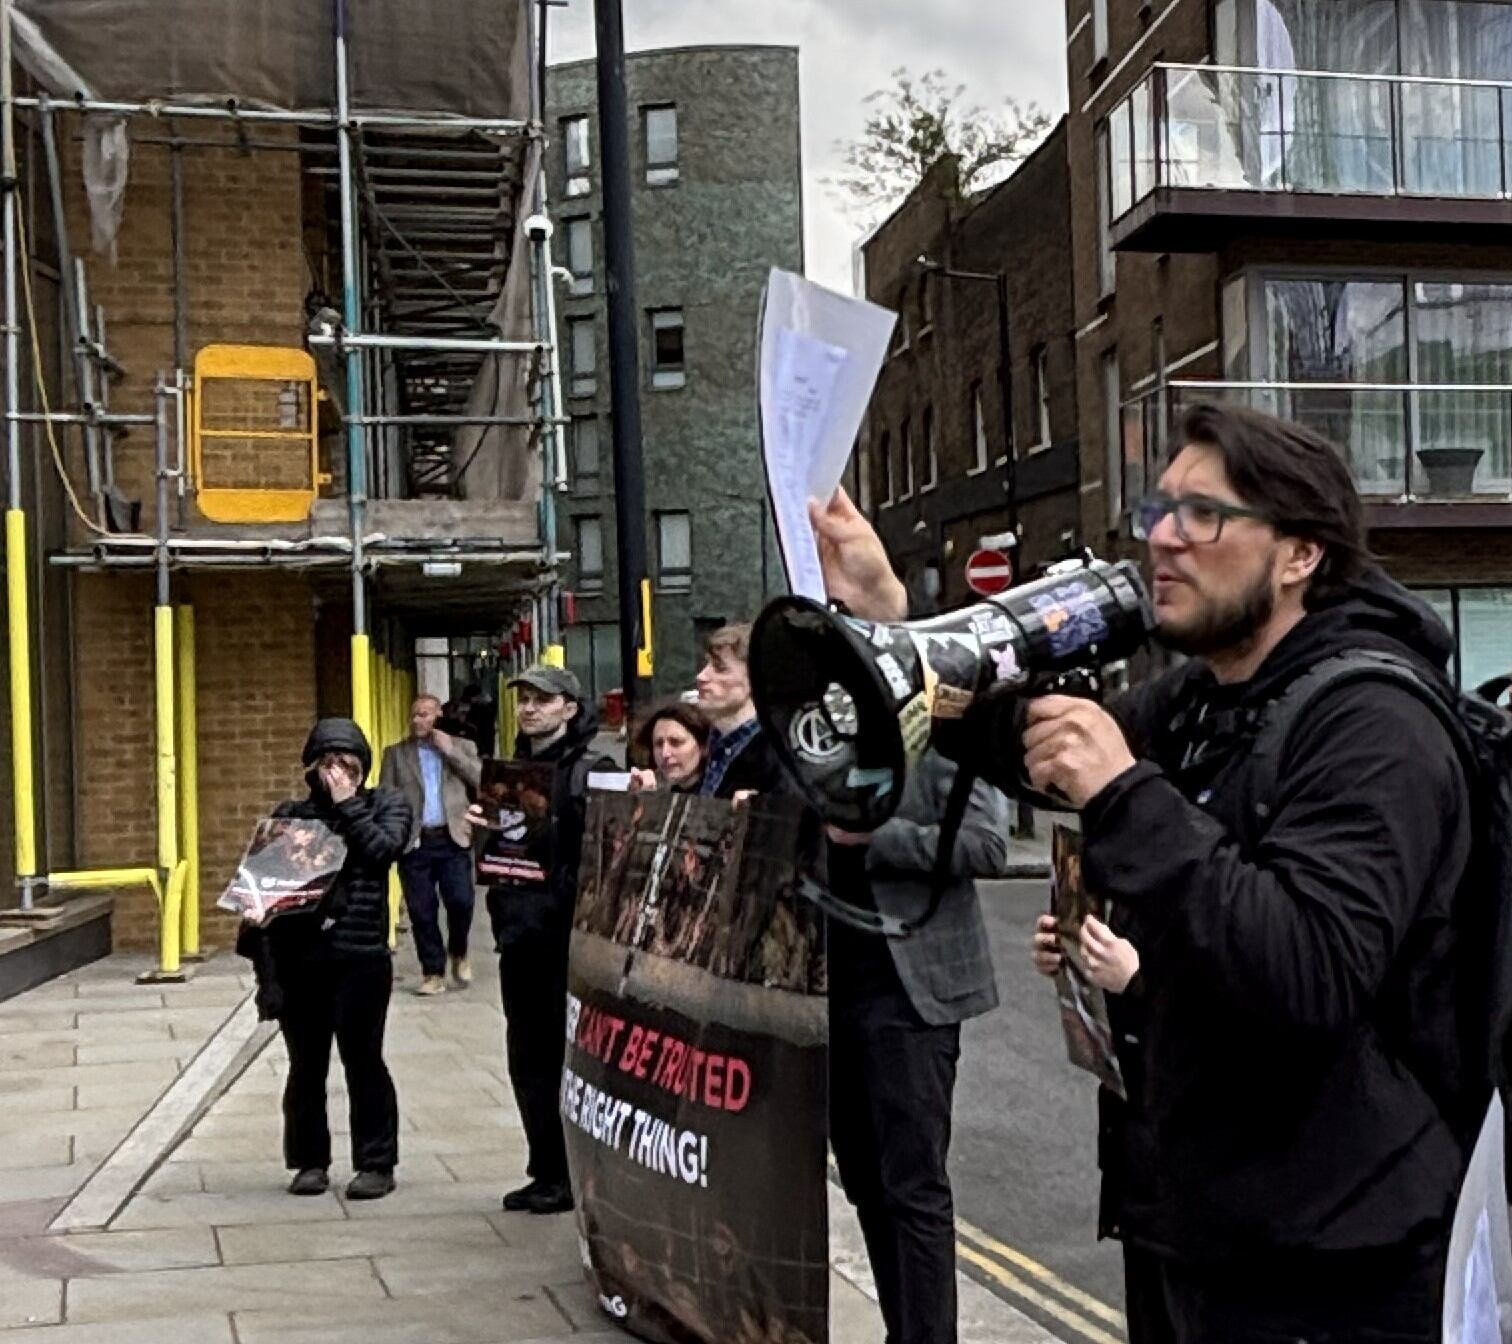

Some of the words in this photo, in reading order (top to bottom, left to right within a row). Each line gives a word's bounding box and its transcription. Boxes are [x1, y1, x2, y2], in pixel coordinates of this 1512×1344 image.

[618, 1024, 660, 1080] BE
[652, 1035, 751, 1112] TRUTED
[628, 1108, 708, 1189] THING!
